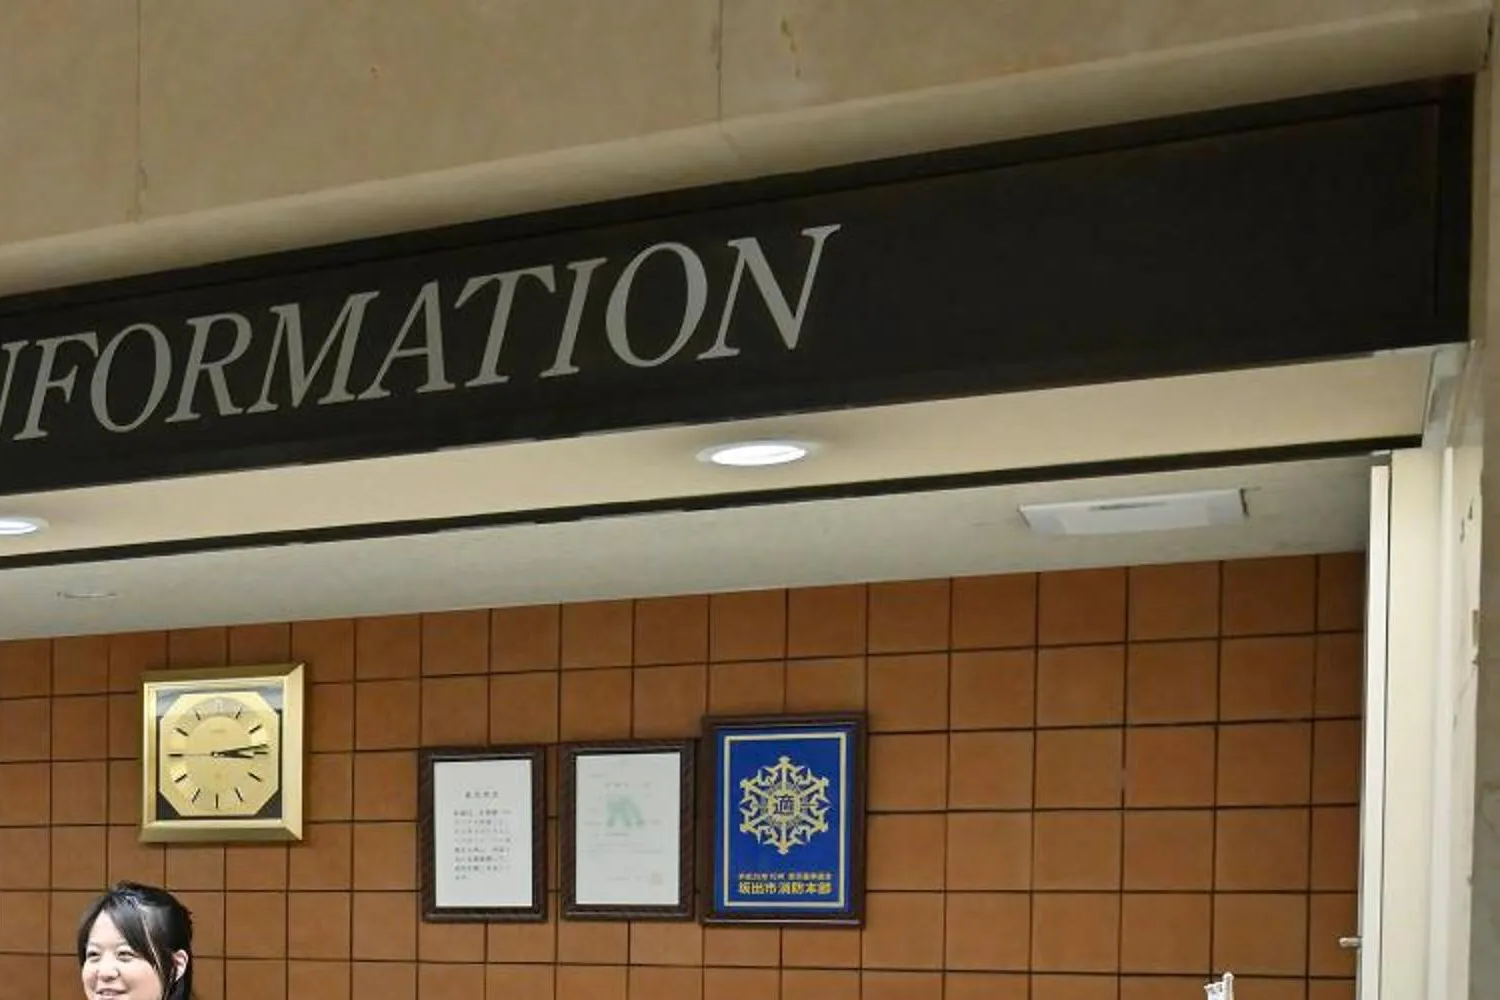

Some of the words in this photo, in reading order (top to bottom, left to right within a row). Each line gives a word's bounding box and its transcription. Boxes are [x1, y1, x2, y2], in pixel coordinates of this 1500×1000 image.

[739, 881, 833, 895] 坂出市消防本部
